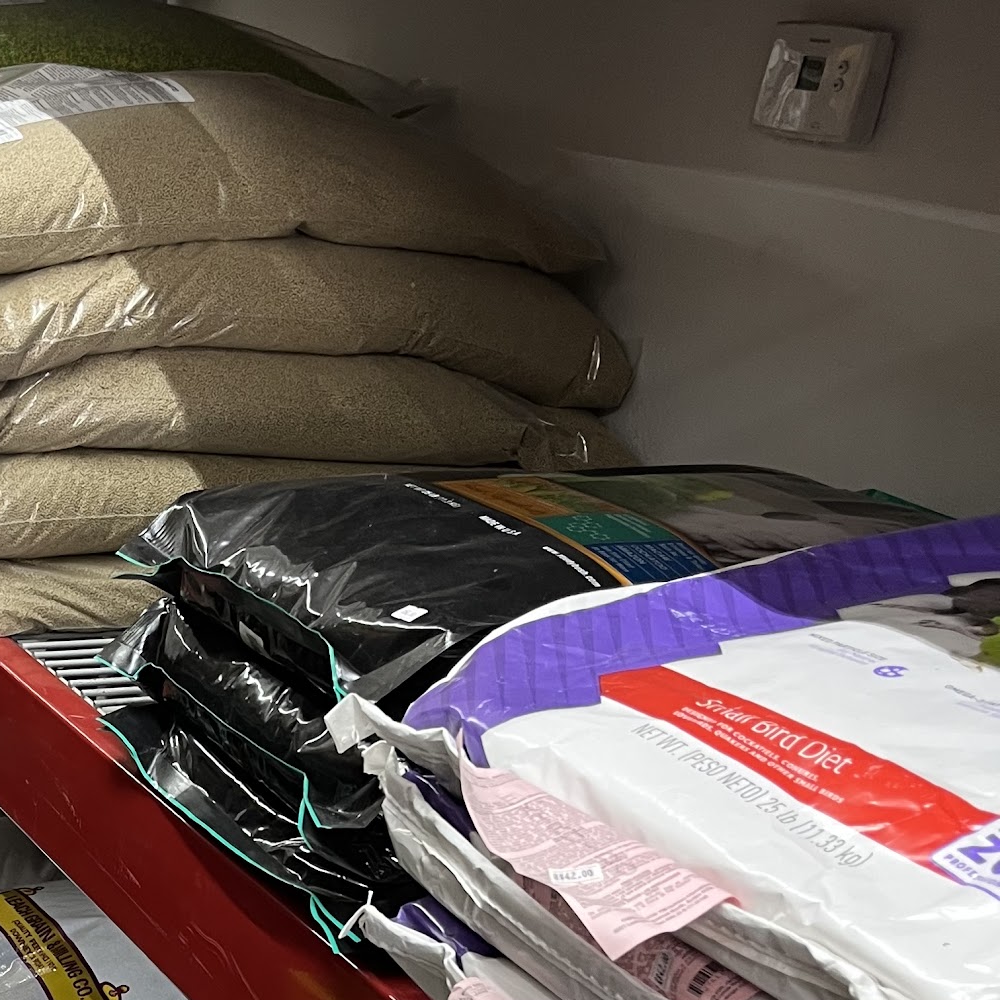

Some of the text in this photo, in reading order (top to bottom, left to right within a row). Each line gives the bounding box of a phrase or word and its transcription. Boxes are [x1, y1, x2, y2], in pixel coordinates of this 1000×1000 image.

[695, 698, 853, 775] Small Bird Diet
[716, 721, 734, 733] FOR
[749, 750, 768, 763] AND
[766, 761, 793, 780] OTHER
[794, 778, 820, 793] SMALL
[631, 723, 668, 743] NET
[652, 731, 688, 756] WT.
[678, 744, 730, 779] (PESO
[716, 770, 770, 805] NETO)
[758, 793, 787, 815] 25
[834, 848, 875, 869] kg)
[957, 833, 1000, 875] 2
[4, 895, 30, 920] LEACH
[25, 914, 56, 945] GRAIN
